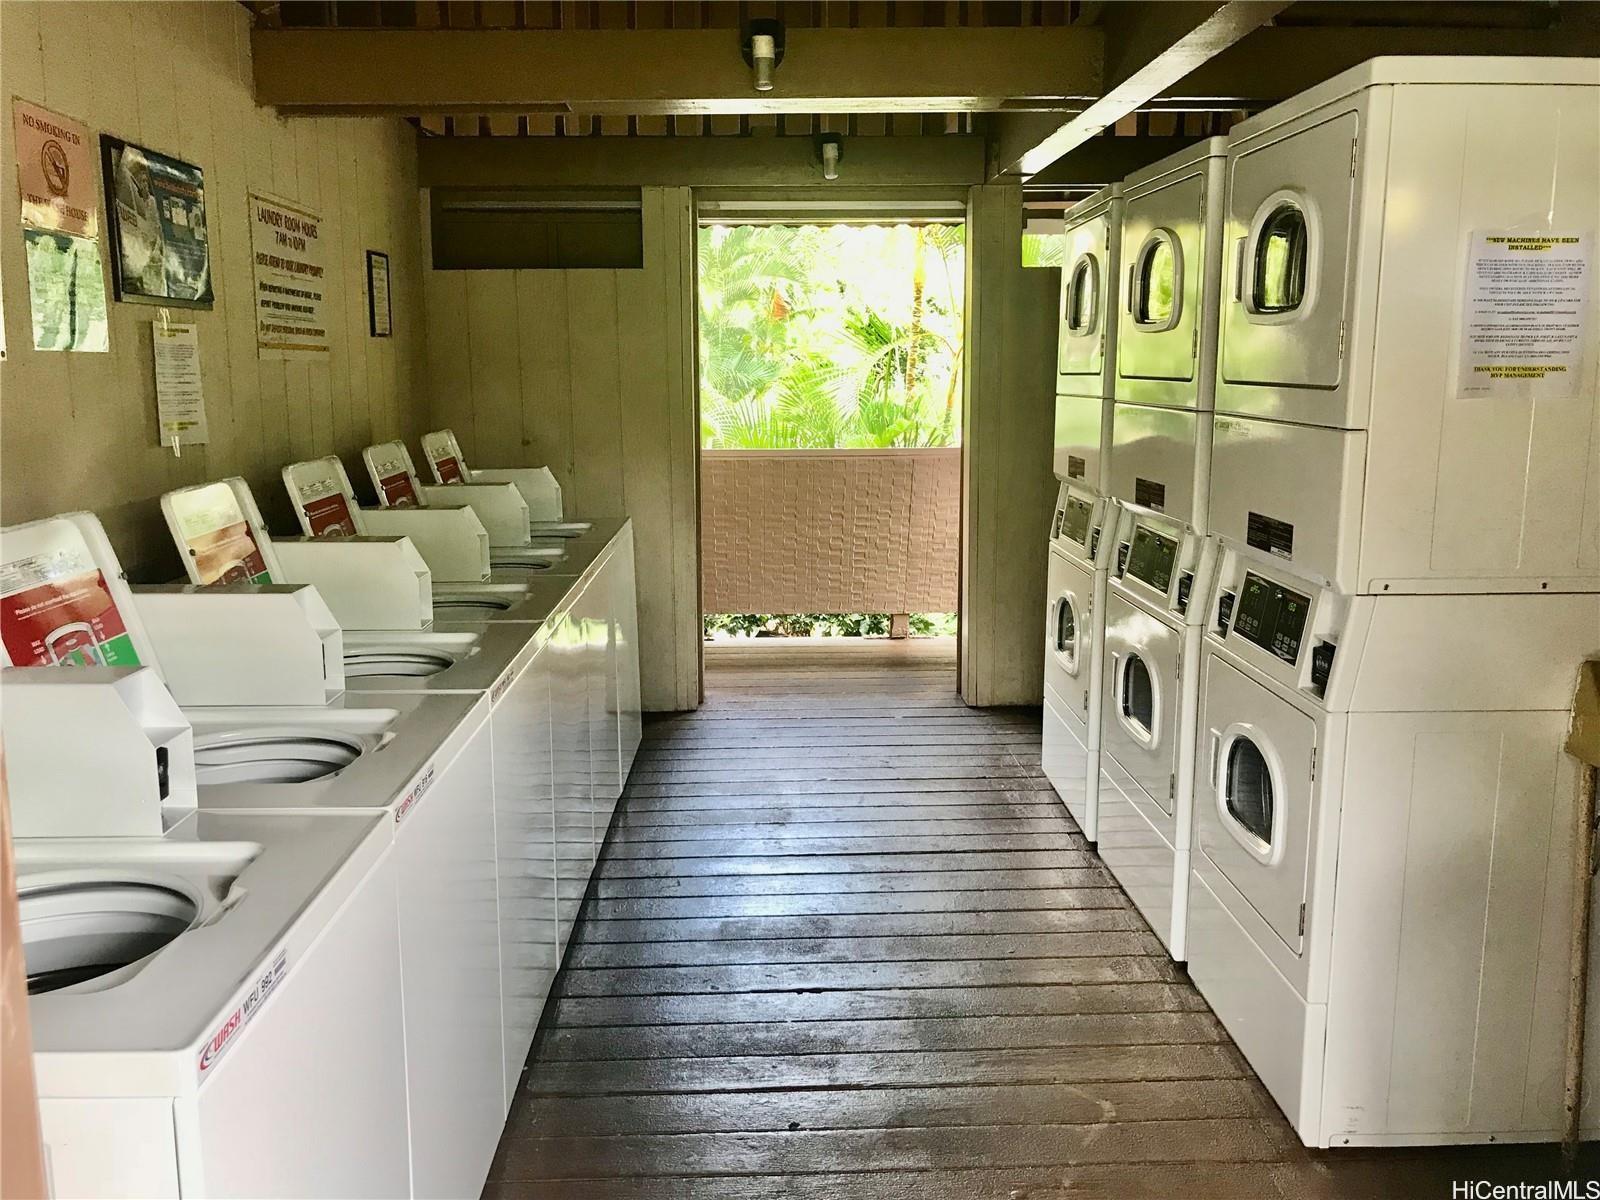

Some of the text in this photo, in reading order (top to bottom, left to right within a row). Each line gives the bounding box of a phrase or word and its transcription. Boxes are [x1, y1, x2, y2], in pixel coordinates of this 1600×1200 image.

[22, 113, 81, 145] NO SMOKING IN
[66, 205, 89, 221] HOUSE
[257, 206, 318, 239] LAUNDRY ROOM HOURS
[1507, 236, 1541, 244] MACHINES
[1541, 236, 1560, 244] HAVE
[1561, 236, 1580, 244] BEEN
[214, 1007, 241, 1053] WASH
